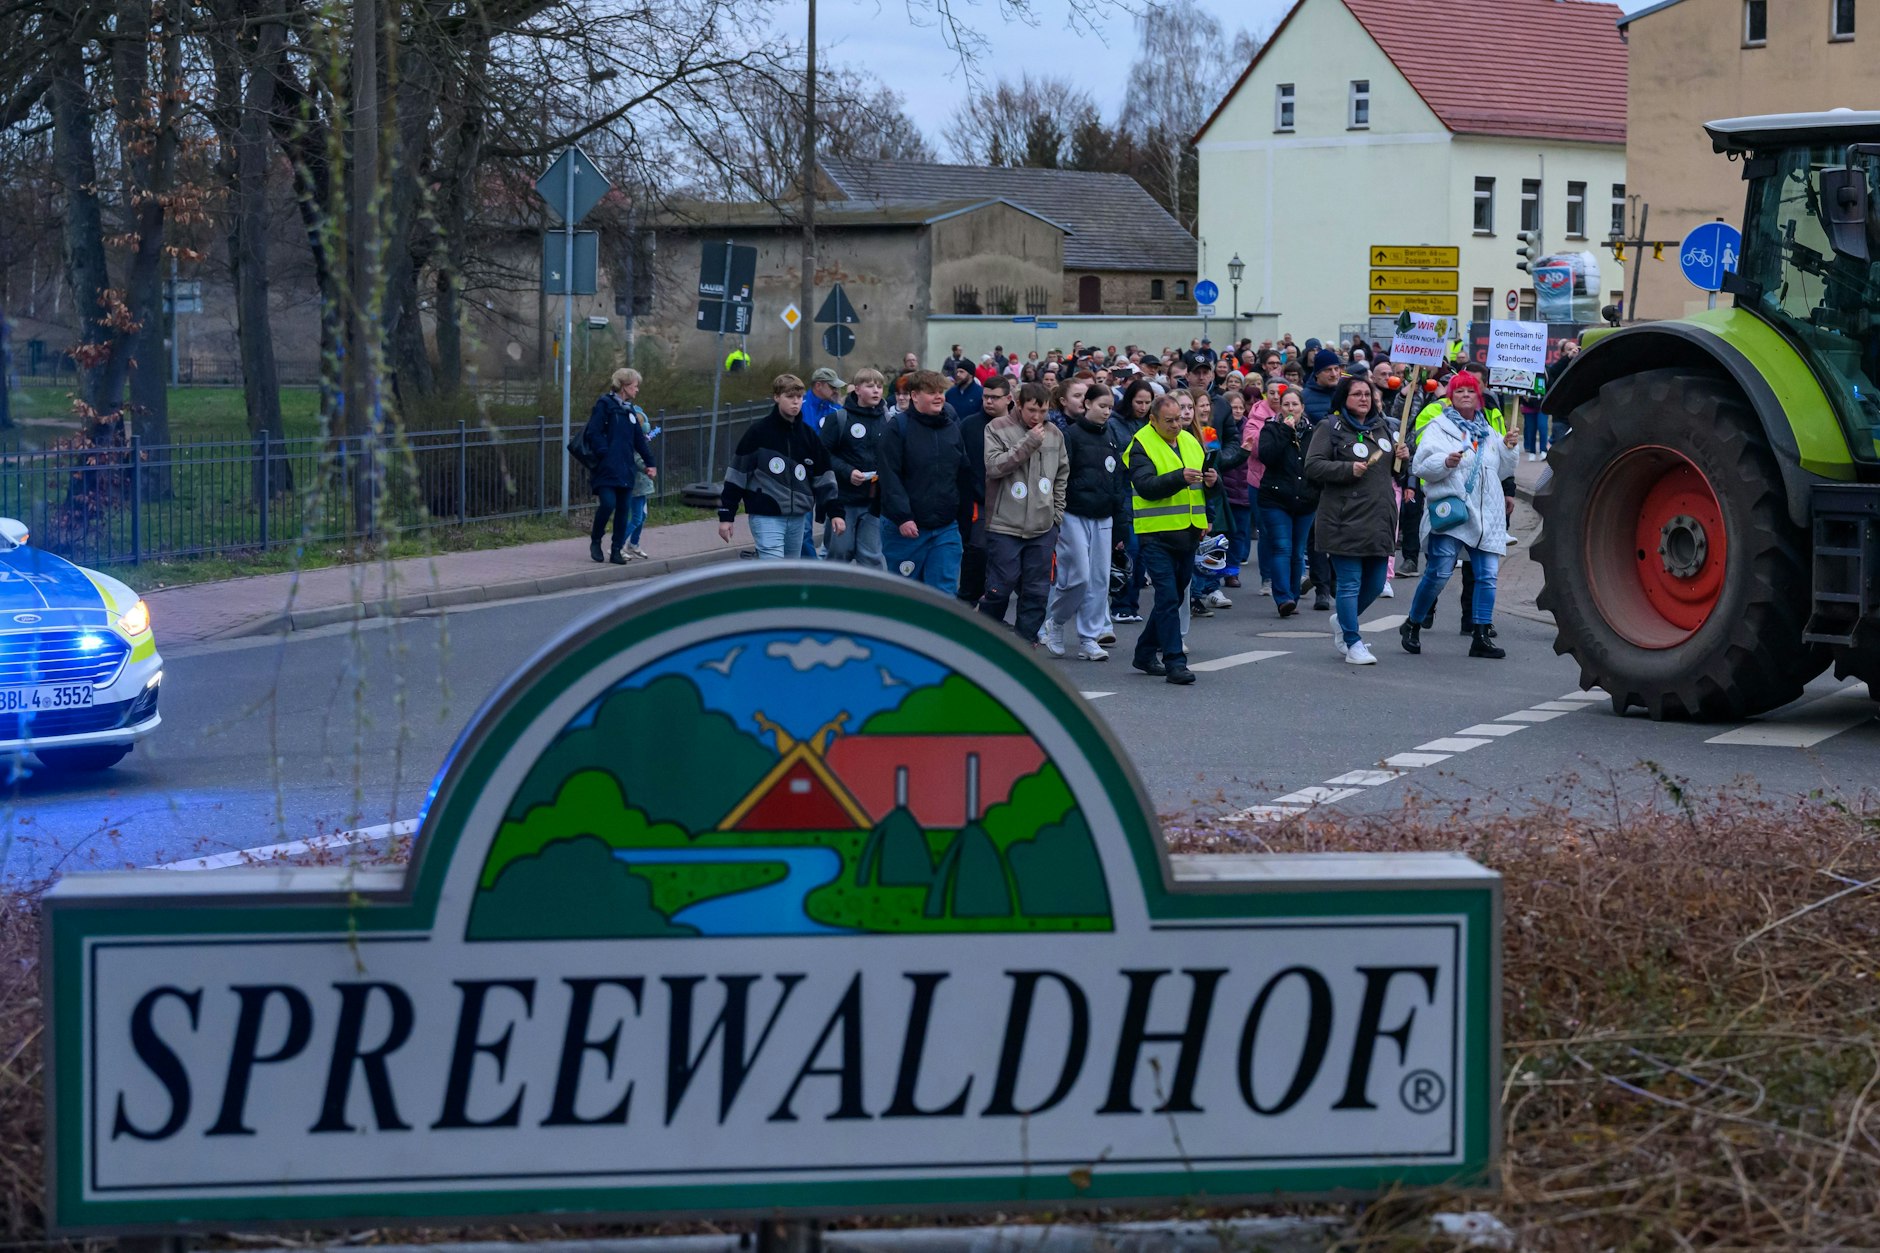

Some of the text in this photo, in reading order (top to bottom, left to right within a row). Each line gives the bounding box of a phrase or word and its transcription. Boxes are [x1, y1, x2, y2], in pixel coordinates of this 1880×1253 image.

[1404, 249, 1427, 257] Berlin
[1418, 321, 1435, 331] WIR
[1494, 329, 1544, 340] Gemeinsam für
[1394, 342, 1442, 358] KÄMPFEN!!!
[1495, 341, 1509, 349] den
[1509, 342, 1530, 351] Erhalt
[1532, 344, 1542, 352] des
[32, 689, 40, 708] 4
[53, 685, 91, 706] 3552
[111, 963, 1440, 1142] SPREEWALDHOF
